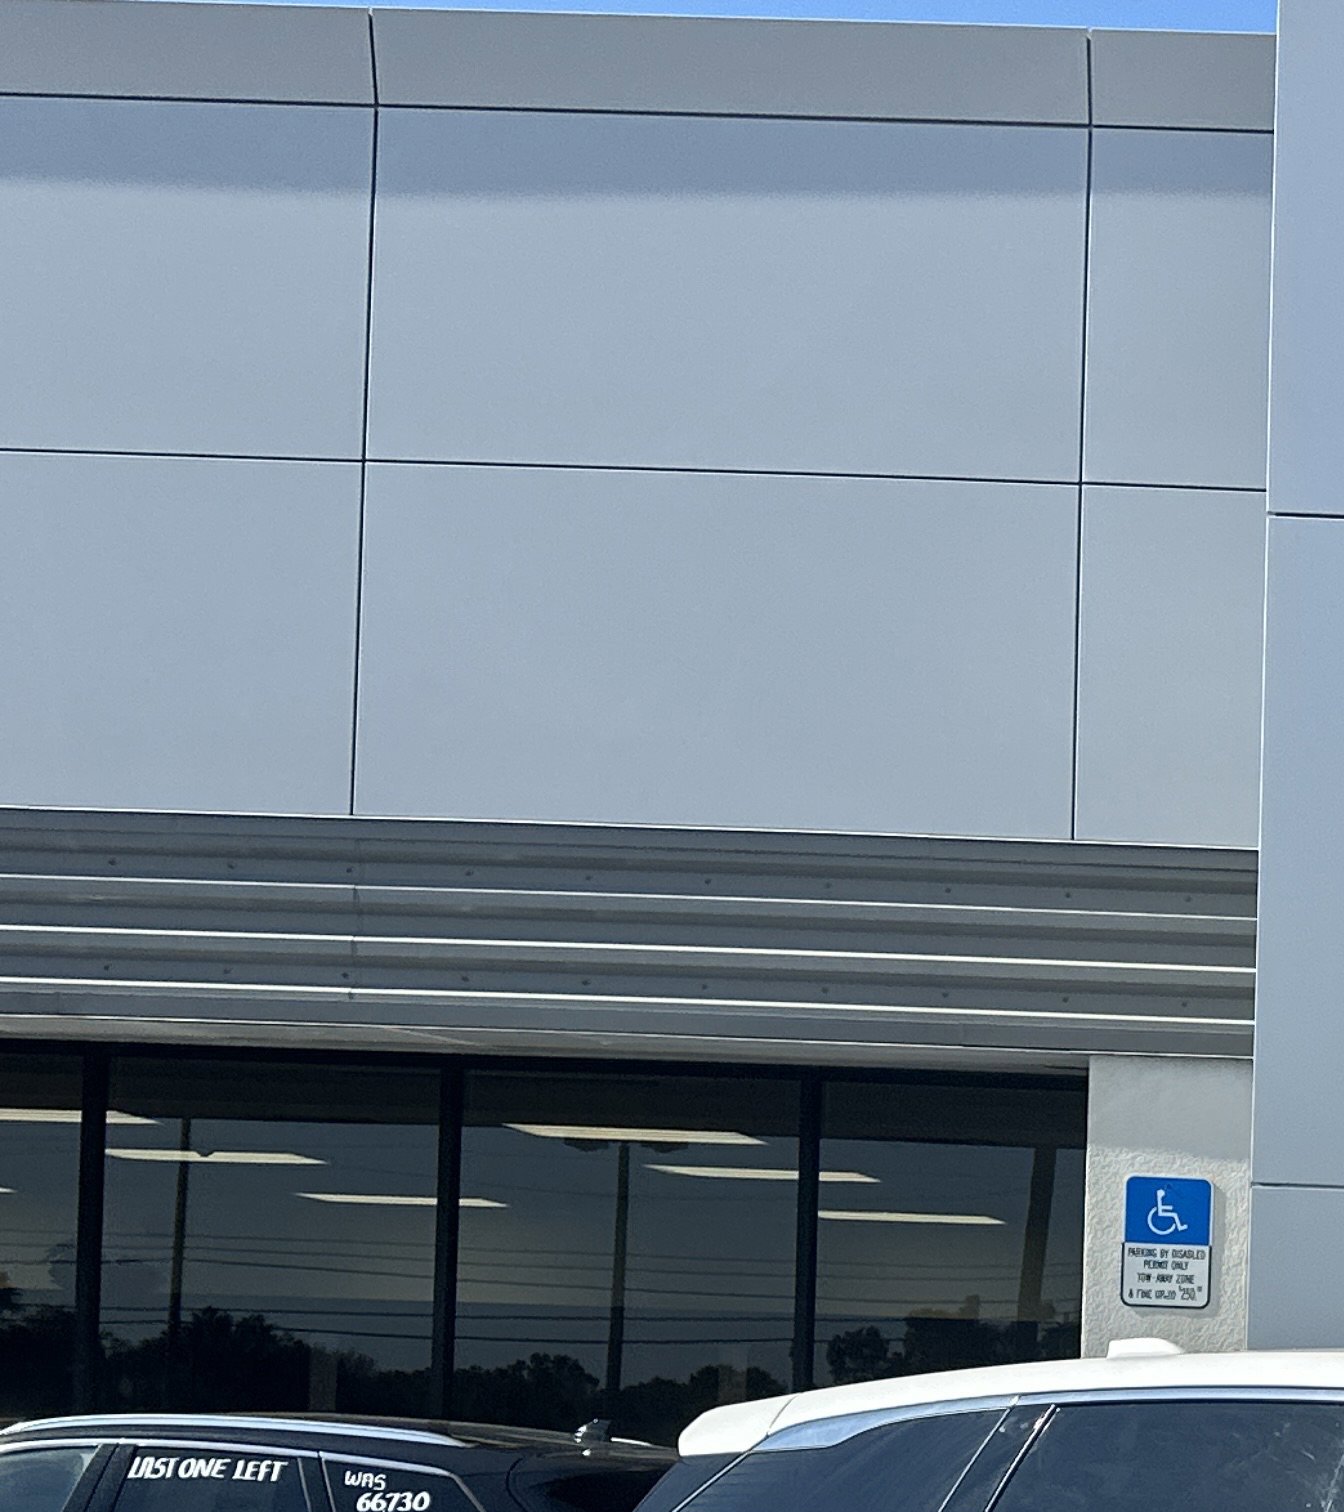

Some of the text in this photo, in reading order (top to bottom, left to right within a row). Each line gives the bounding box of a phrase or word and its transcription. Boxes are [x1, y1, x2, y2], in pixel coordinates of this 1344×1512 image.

[127, 1456, 289, 1482] LAST ONE LEFT
[344, 1470, 387, 1491] WAS
